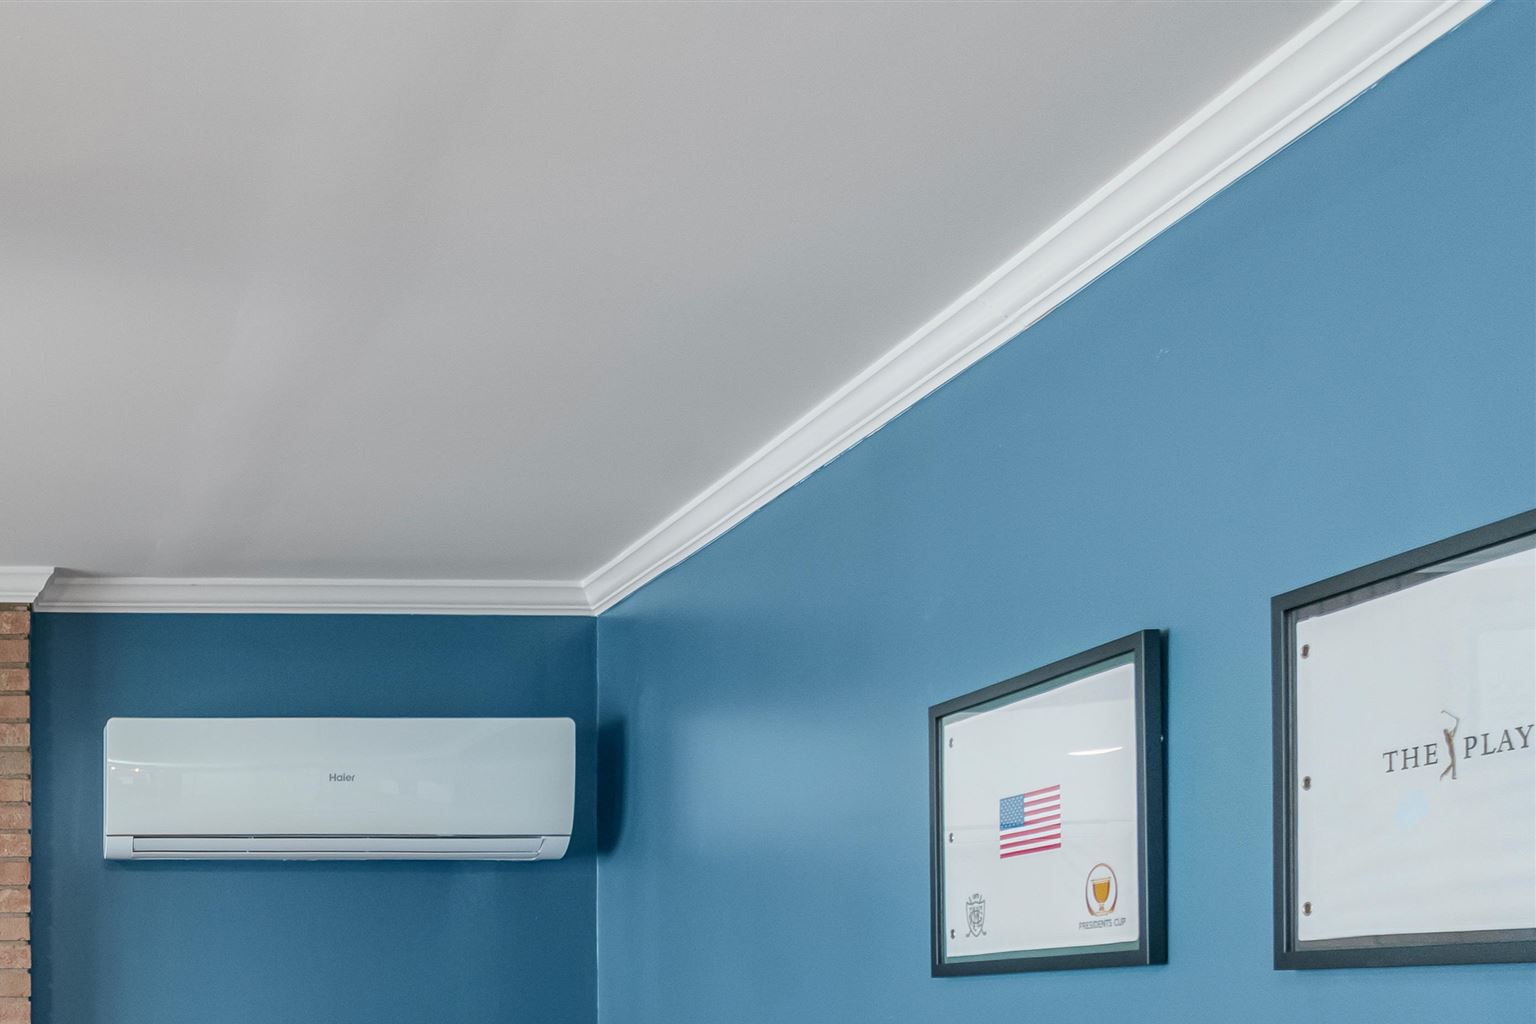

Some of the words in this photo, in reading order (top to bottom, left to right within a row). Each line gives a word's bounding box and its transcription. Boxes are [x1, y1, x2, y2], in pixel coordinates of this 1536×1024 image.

[1382, 743, 1439, 773] THE
[1464, 724, 1535, 760] PLAY
[328, 772, 356, 782] Haier
